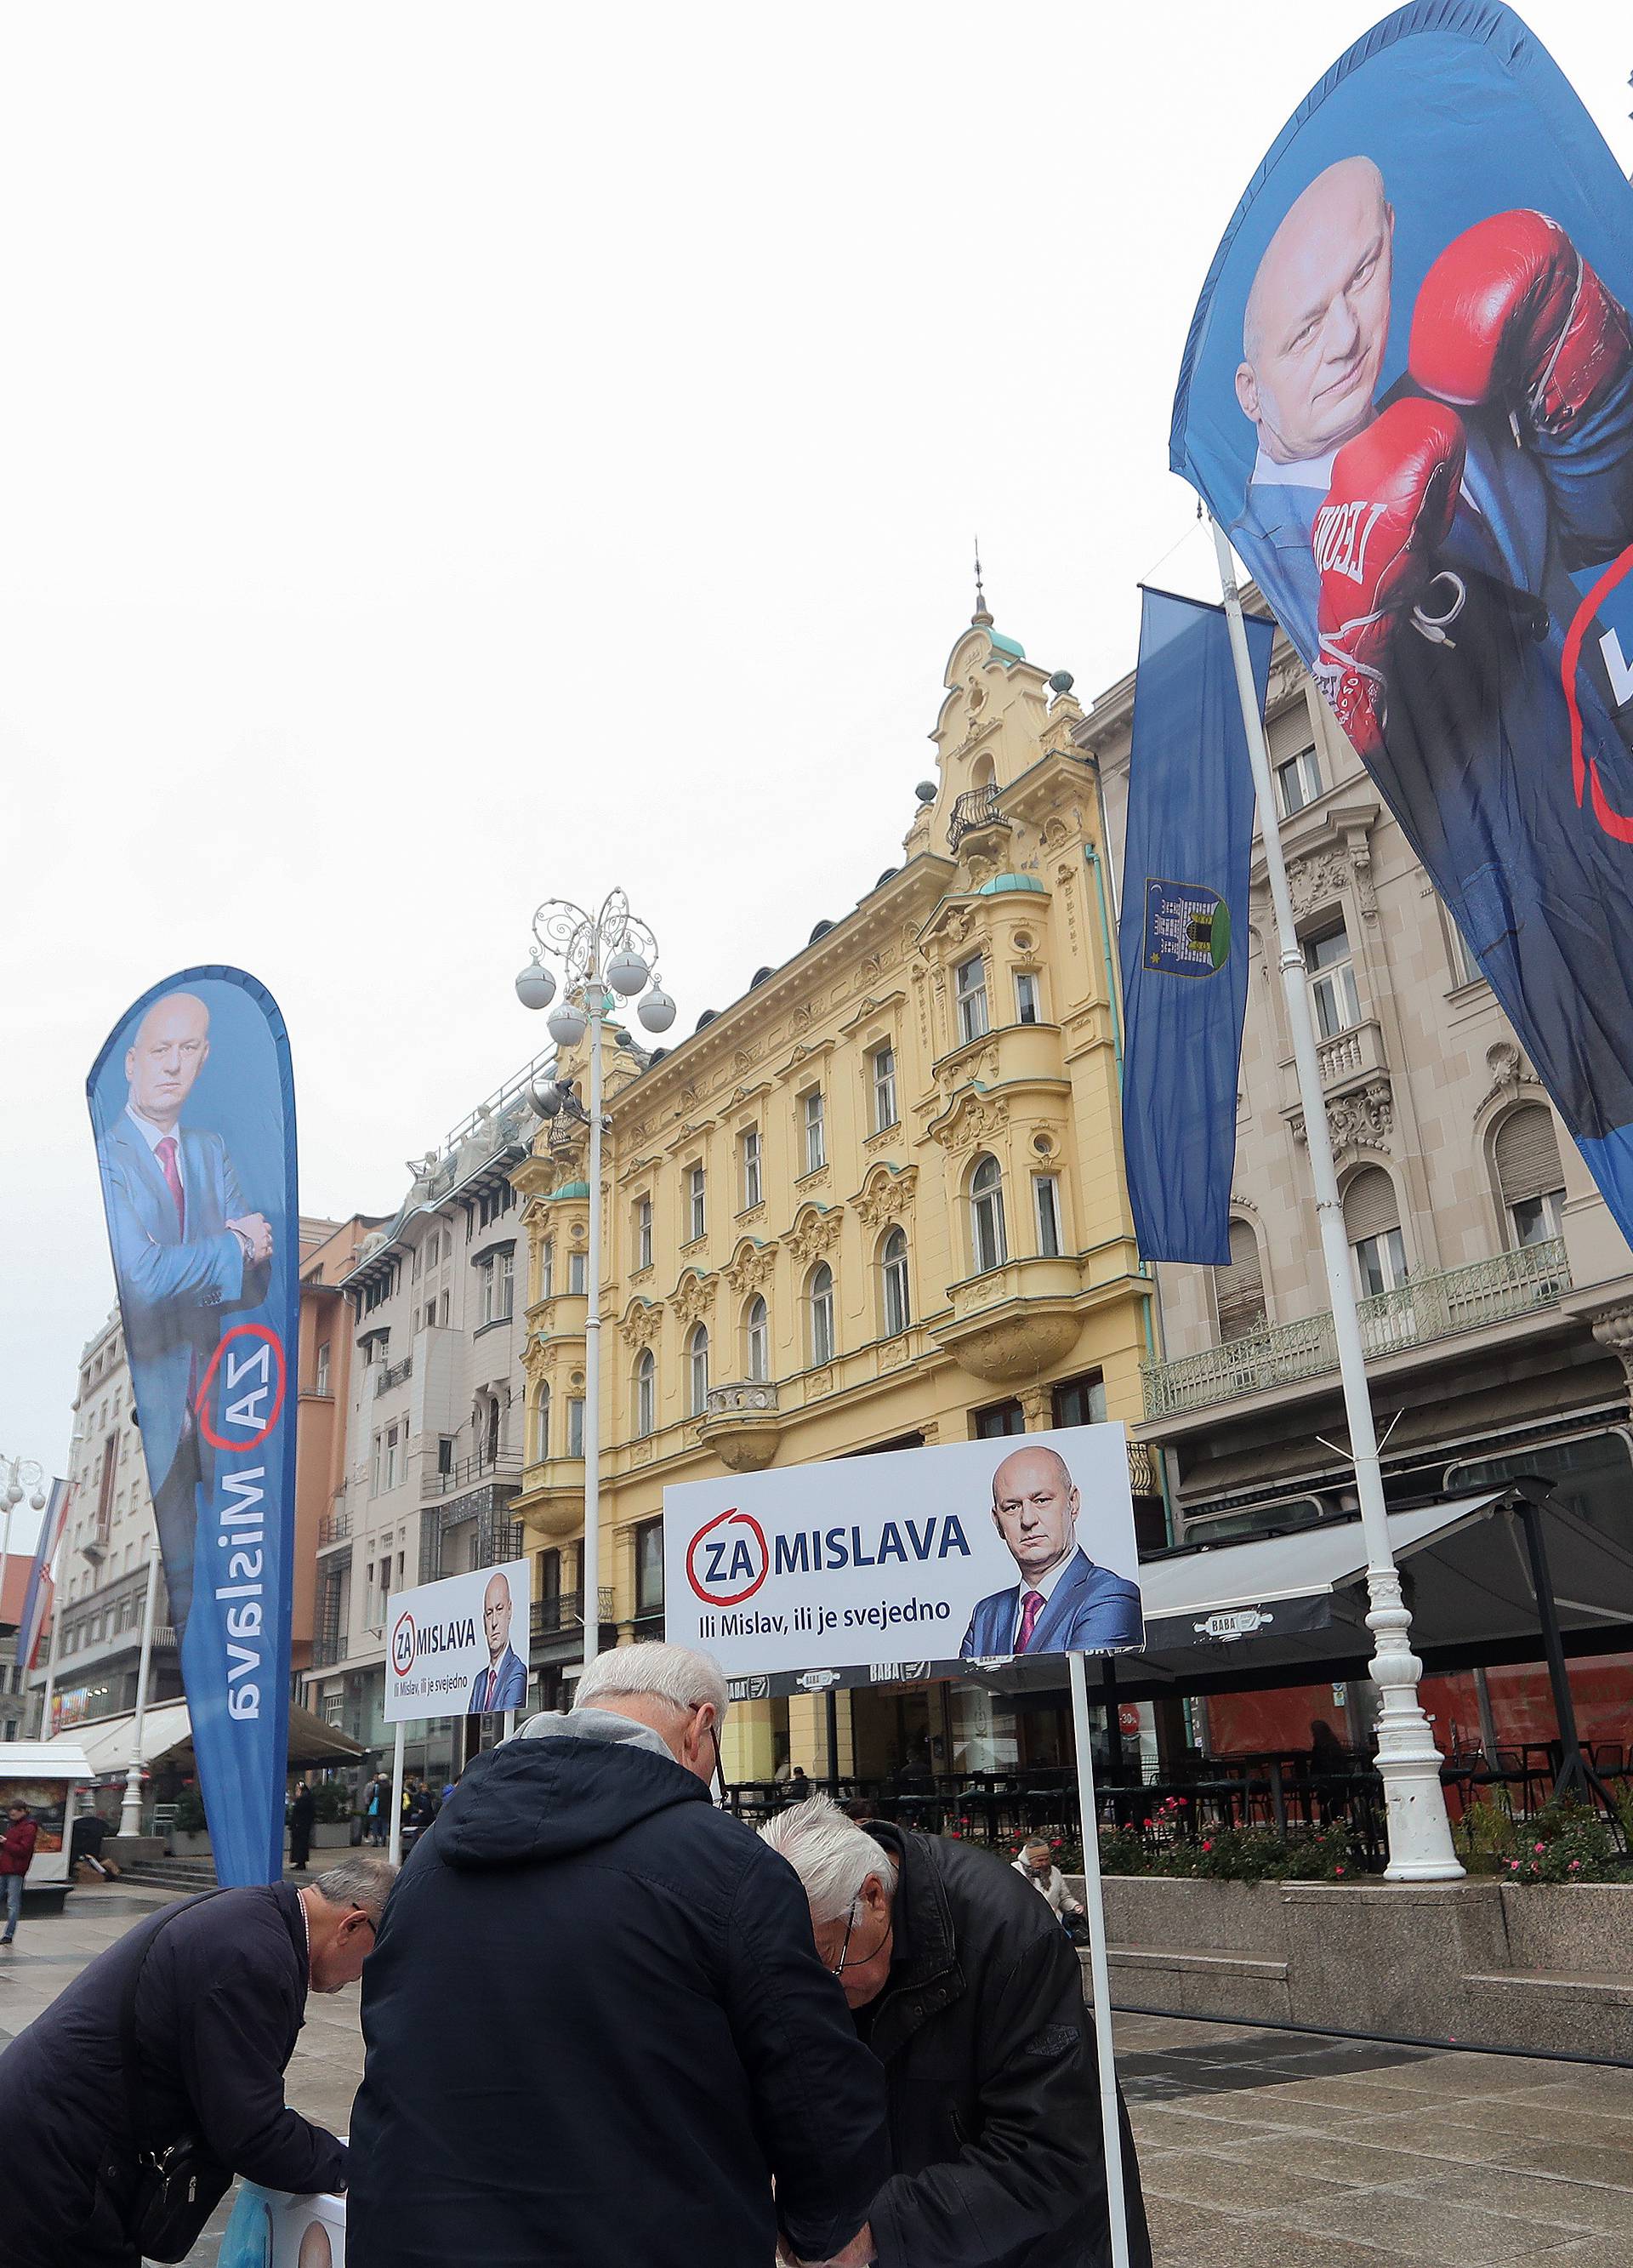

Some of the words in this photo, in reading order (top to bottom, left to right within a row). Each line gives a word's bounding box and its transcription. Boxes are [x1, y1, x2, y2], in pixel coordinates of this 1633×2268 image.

[704, 1539, 755, 1582] ZA
[775, 1514, 972, 1576] MISLAVA
[699, 1616, 715, 1638] Ili
[720, 1610, 789, 1637] Mislav,
[794, 1606, 812, 1631] ili
[816, 1605, 838, 1636] je
[843, 1596, 951, 1631] svejedno
[1212, 1617, 1236, 1633] BABA
[397, 1632, 412, 1661] ZA
[416, 1618, 476, 1657] MISLAVA
[869, 1662, 901, 1683] BABA
[427, 1678, 435, 1697] je
[435, 1673, 469, 1695] svejedno
[726, 1681, 747, 1701] ABA
